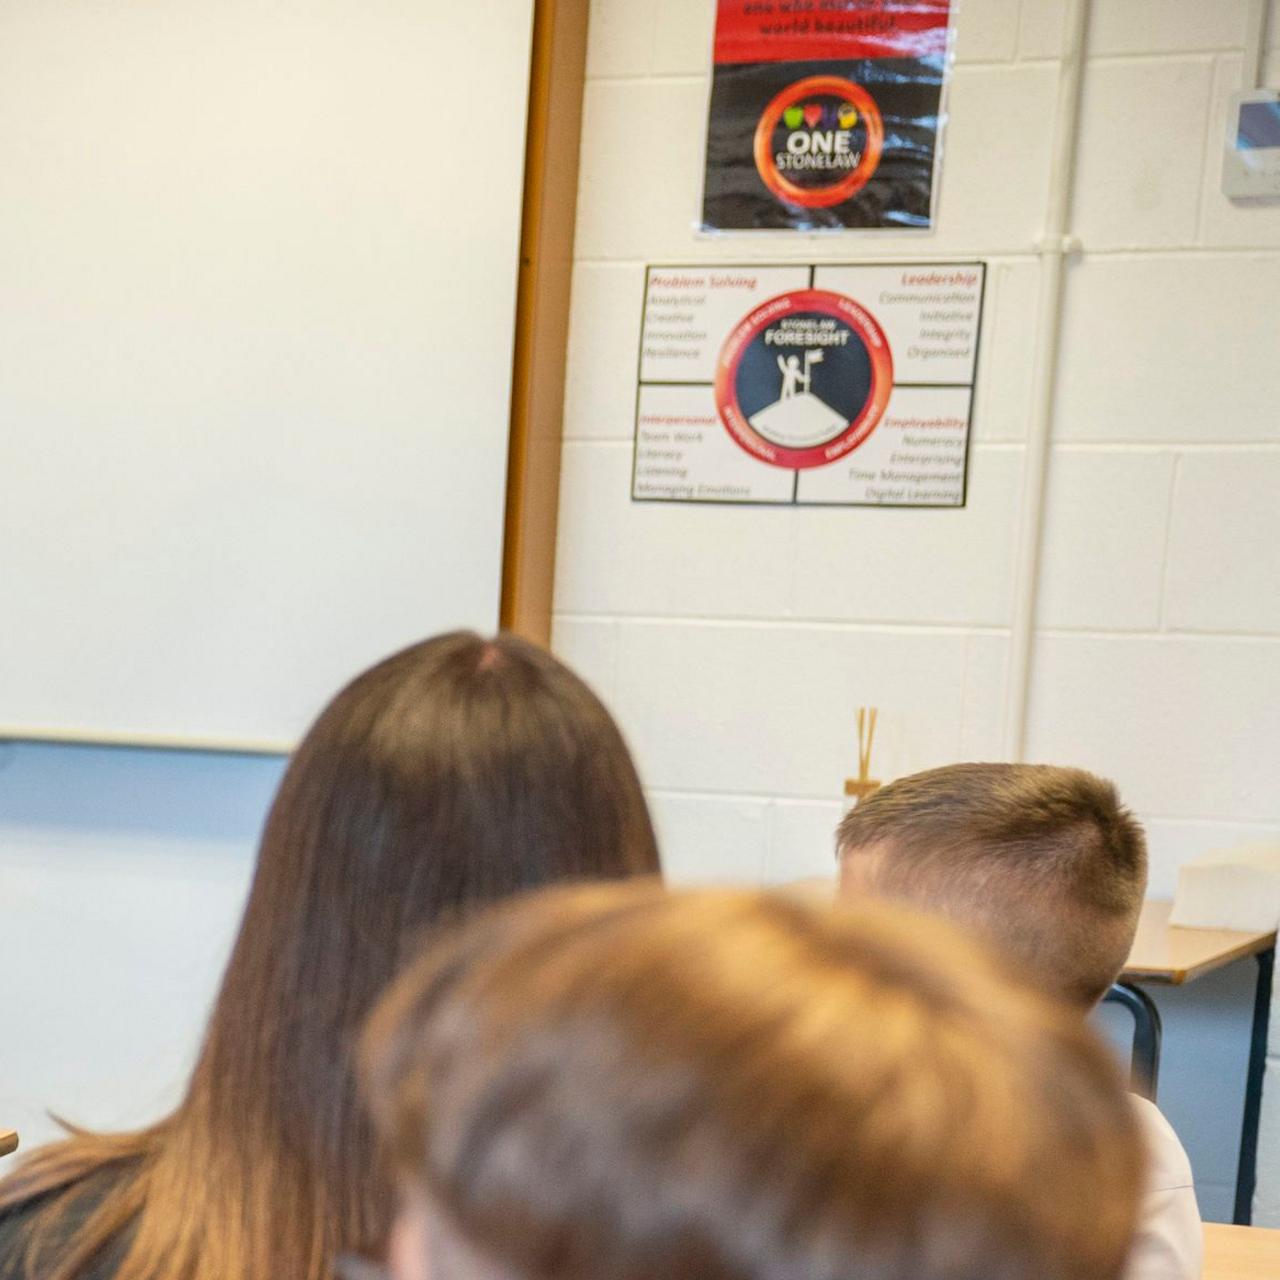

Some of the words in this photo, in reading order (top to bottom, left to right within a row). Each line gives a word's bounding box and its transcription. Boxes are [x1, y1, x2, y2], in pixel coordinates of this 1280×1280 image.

[787, 131, 852, 155] ONE
[775, 152, 861, 169] STONELAW
[901, 272, 977, 287] Leadership
[765, 330, 849, 346] FORESIGHT
